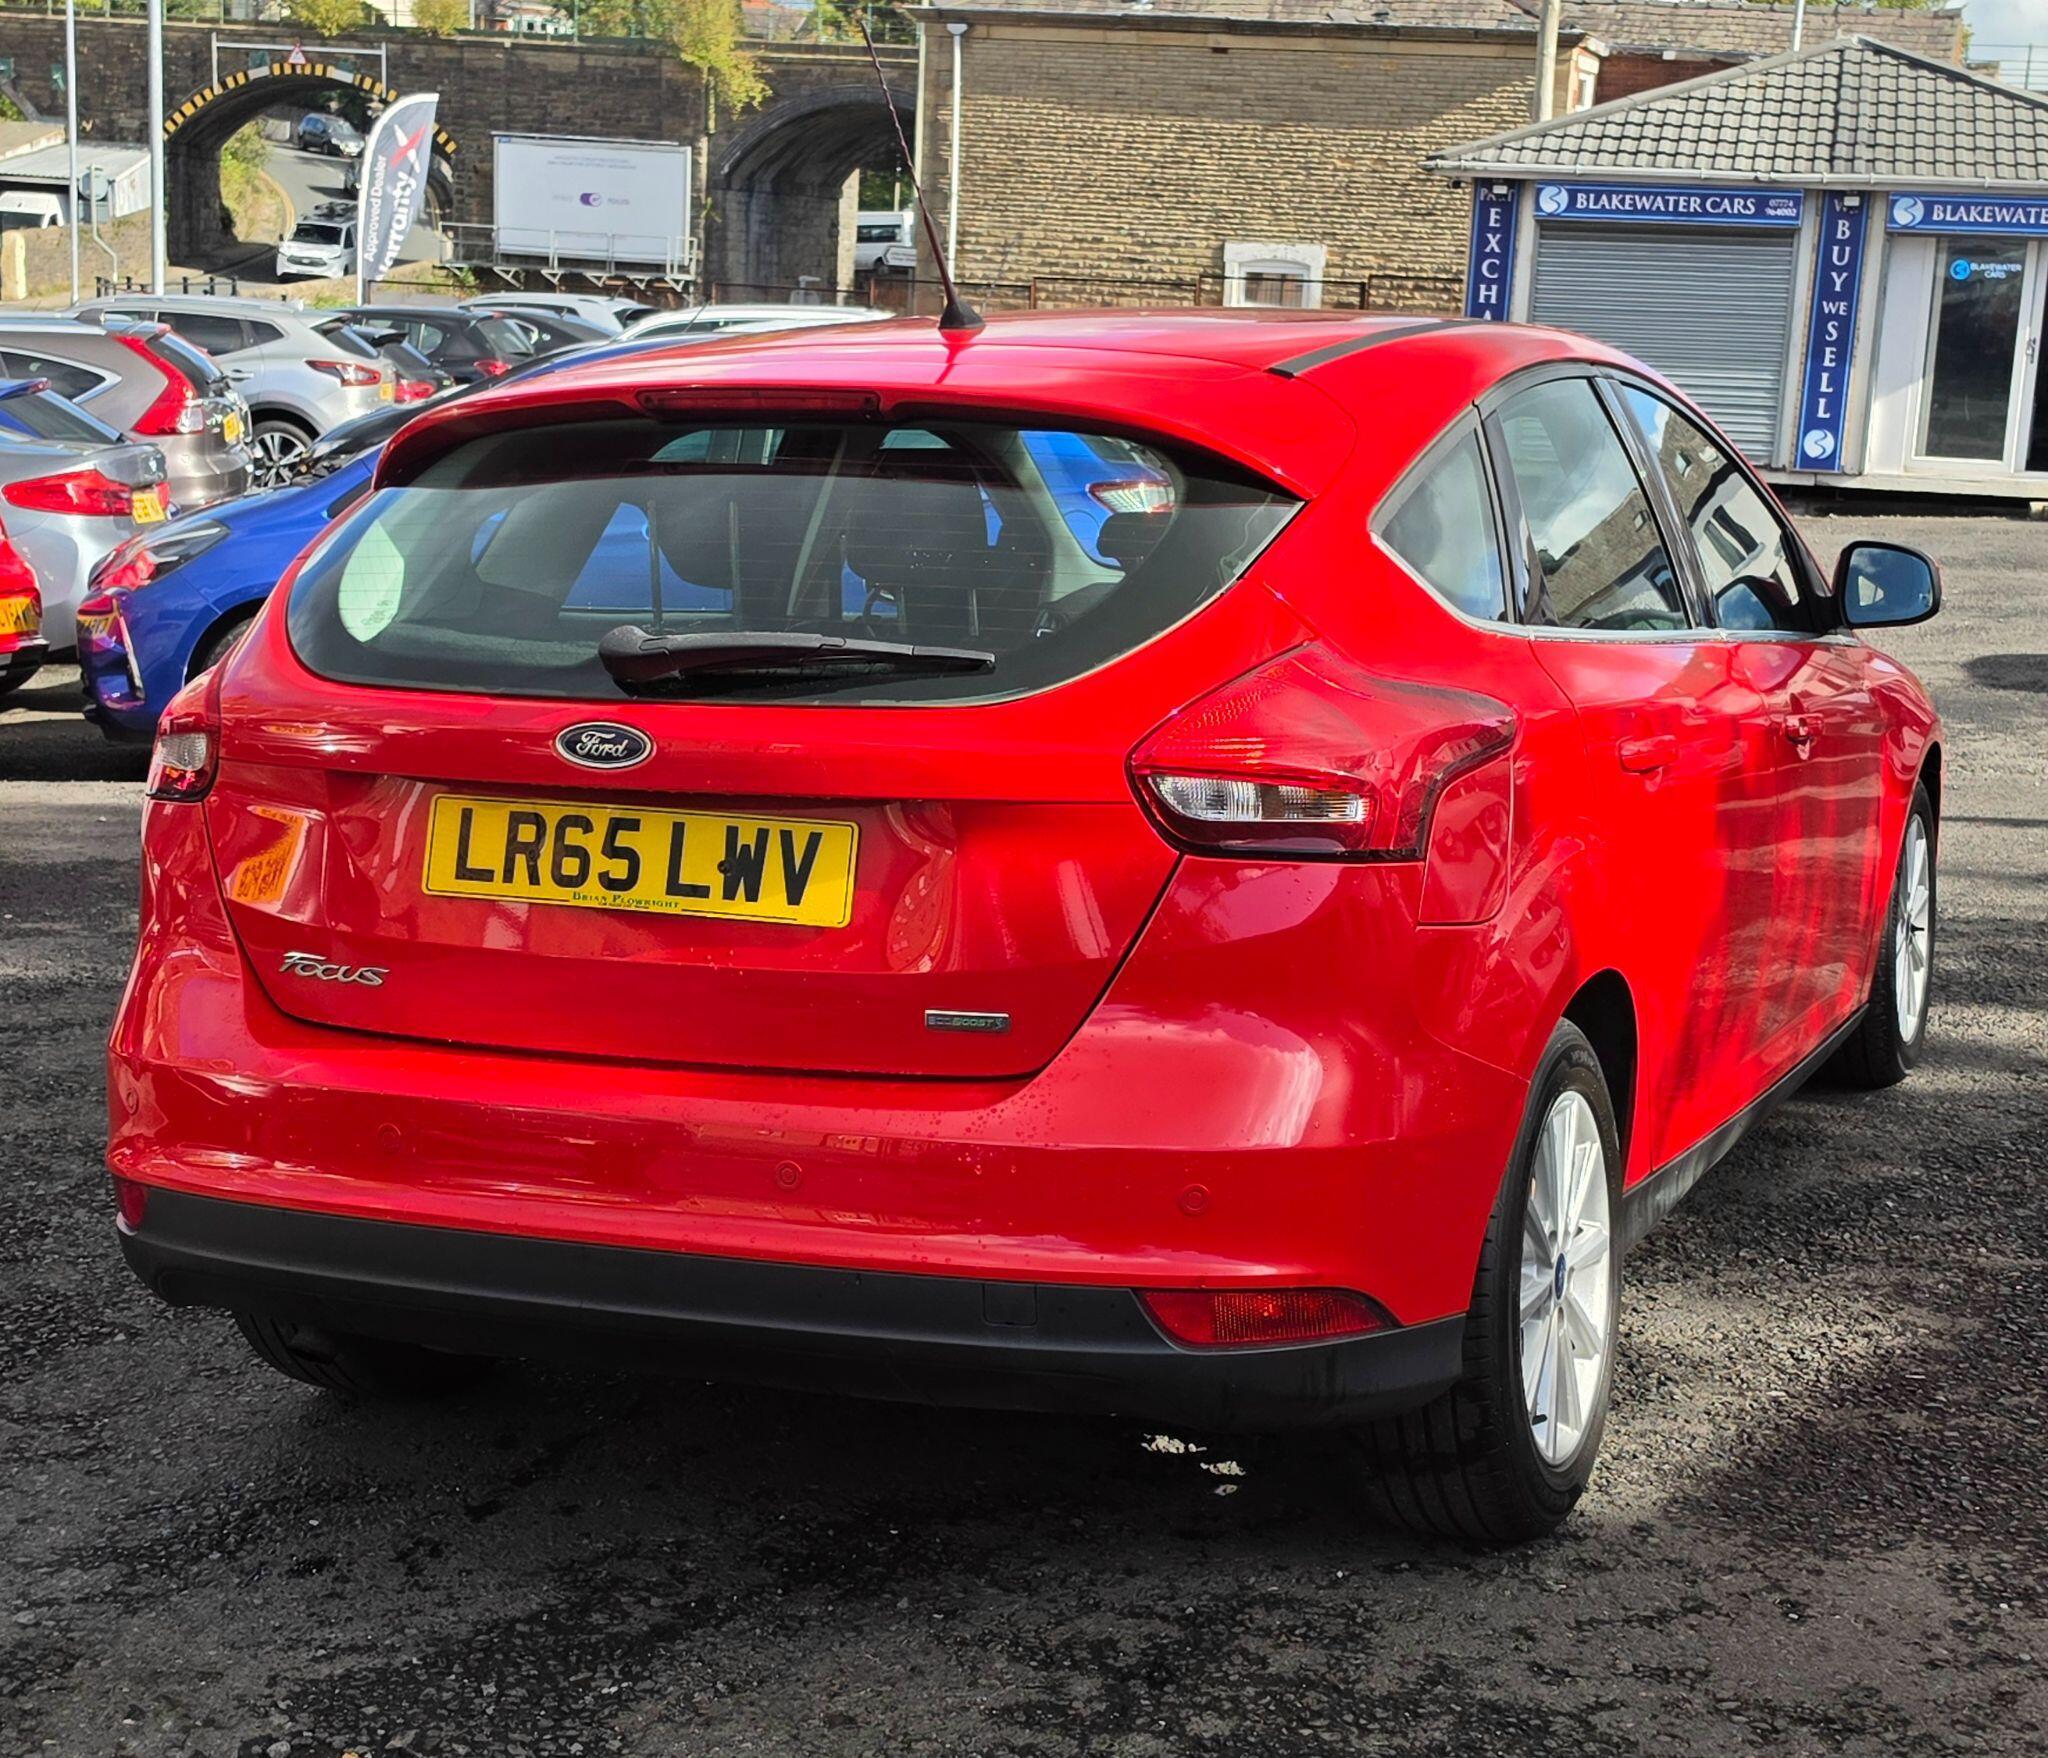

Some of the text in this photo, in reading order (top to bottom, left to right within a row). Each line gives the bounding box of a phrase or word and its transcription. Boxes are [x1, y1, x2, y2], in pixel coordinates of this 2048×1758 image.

[363, 154, 387, 262] Approved Dealer
[1575, 192, 1756, 215] BLAKEWATER CARS
[1831, 219, 1851, 292] BUY
[1822, 301, 1848, 315] WE
[1817, 321, 1839, 418] SELL
[576, 731, 629, 757] Ford
[454, 807, 824, 907] LR65 LWV
